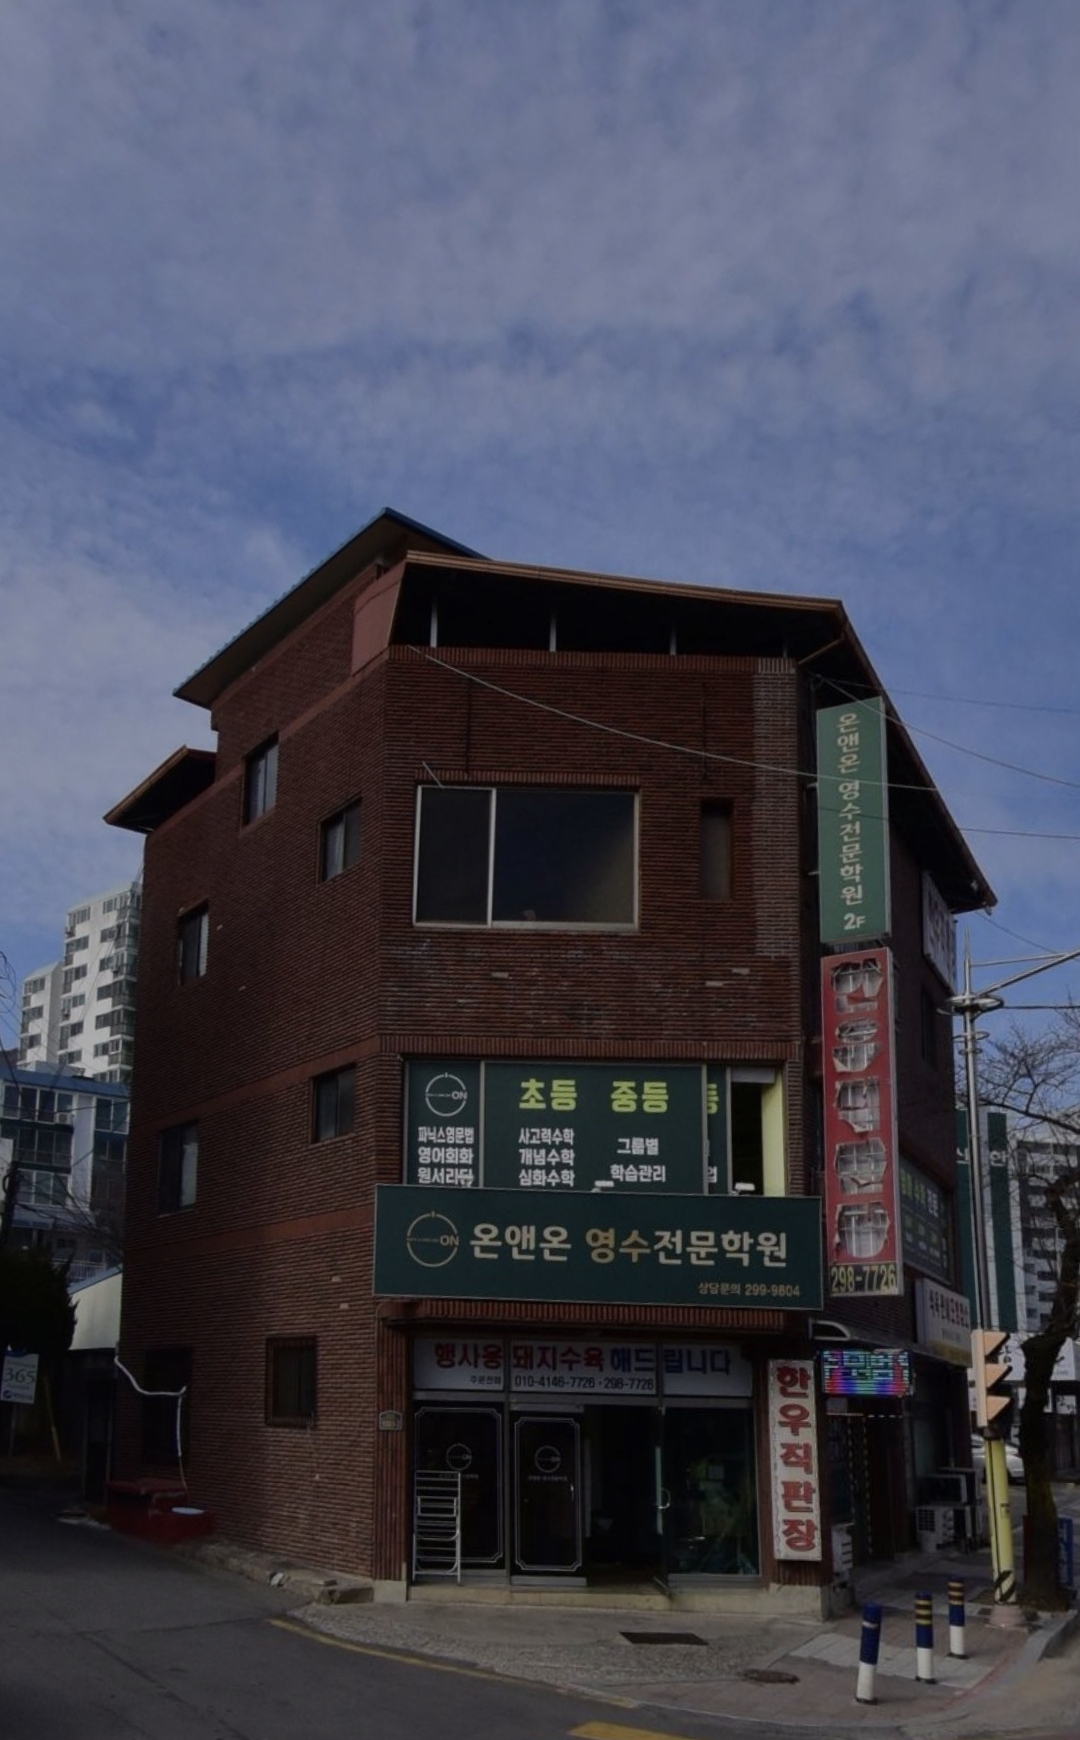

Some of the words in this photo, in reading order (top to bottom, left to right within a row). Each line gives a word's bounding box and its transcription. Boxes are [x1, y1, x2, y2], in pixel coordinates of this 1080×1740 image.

[837, 713, 861, 774] 온앤온
[838, 779, 863, 905] 영수전문학원
[843, 913, 866, 930] 2F
[451, 1090, 468, 1100] ON
[518, 1078, 577, 1111] 초등
[610, 1081, 669, 1113] 중등
[417, 1126, 475, 1144] 파닉스영문법
[518, 1127, 575, 1146] 사고력수학
[417, 1146, 475, 1165] 영어회화
[616, 1137, 659, 1155] 그룹별
[518, 1148, 575, 1166] 개념수학
[518, 1169, 575, 1187] 심화수학
[609, 1163, 666, 1183] 학습관리
[440, 1234, 460, 1247] ON
[469, 1222, 572, 1261] 온앤온
[585, 1227, 787, 1267] 영수전문학원
[830, 1263, 897, 1293] 298-7726
[698, 1281, 741, 1295] 상담문의
[744, 1283, 800, 1297] 299-9804
[434, 1343, 502, 1369] 행사용
[513, 1345, 605, 1371] 돼지수육
[610, 1347, 731, 1374] 해드립니다
[776, 1366, 819, 1550] 한우직판장
